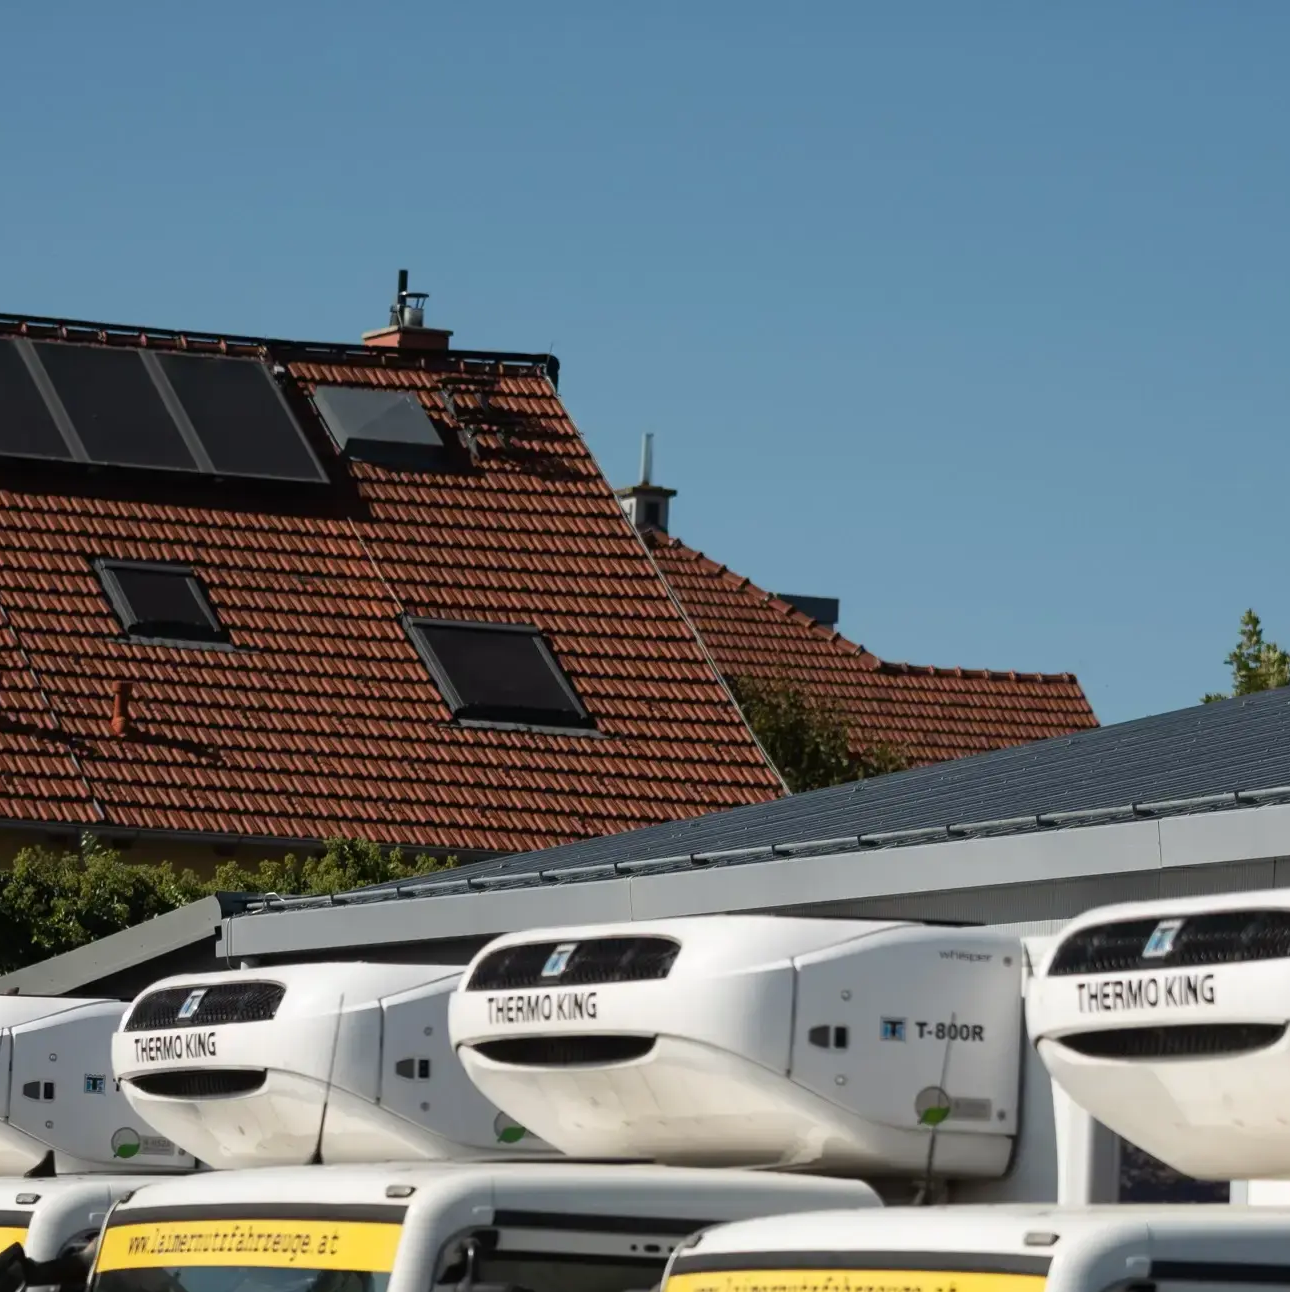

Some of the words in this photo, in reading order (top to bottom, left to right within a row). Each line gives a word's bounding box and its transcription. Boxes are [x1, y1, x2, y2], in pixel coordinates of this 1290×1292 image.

[487, 993, 552, 1025] THERMO
[556, 991, 597, 1020] KING
[1077, 977, 1158, 1014] THERMO
[1164, 974, 1216, 1006] KING
[134, 1033, 182, 1063] THERMO
[185, 1031, 216, 1058] KING
[915, 1022, 985, 1042] T-800R
[128, 1225, 340, 1262] www.laimernutzfahrzeuge.at
